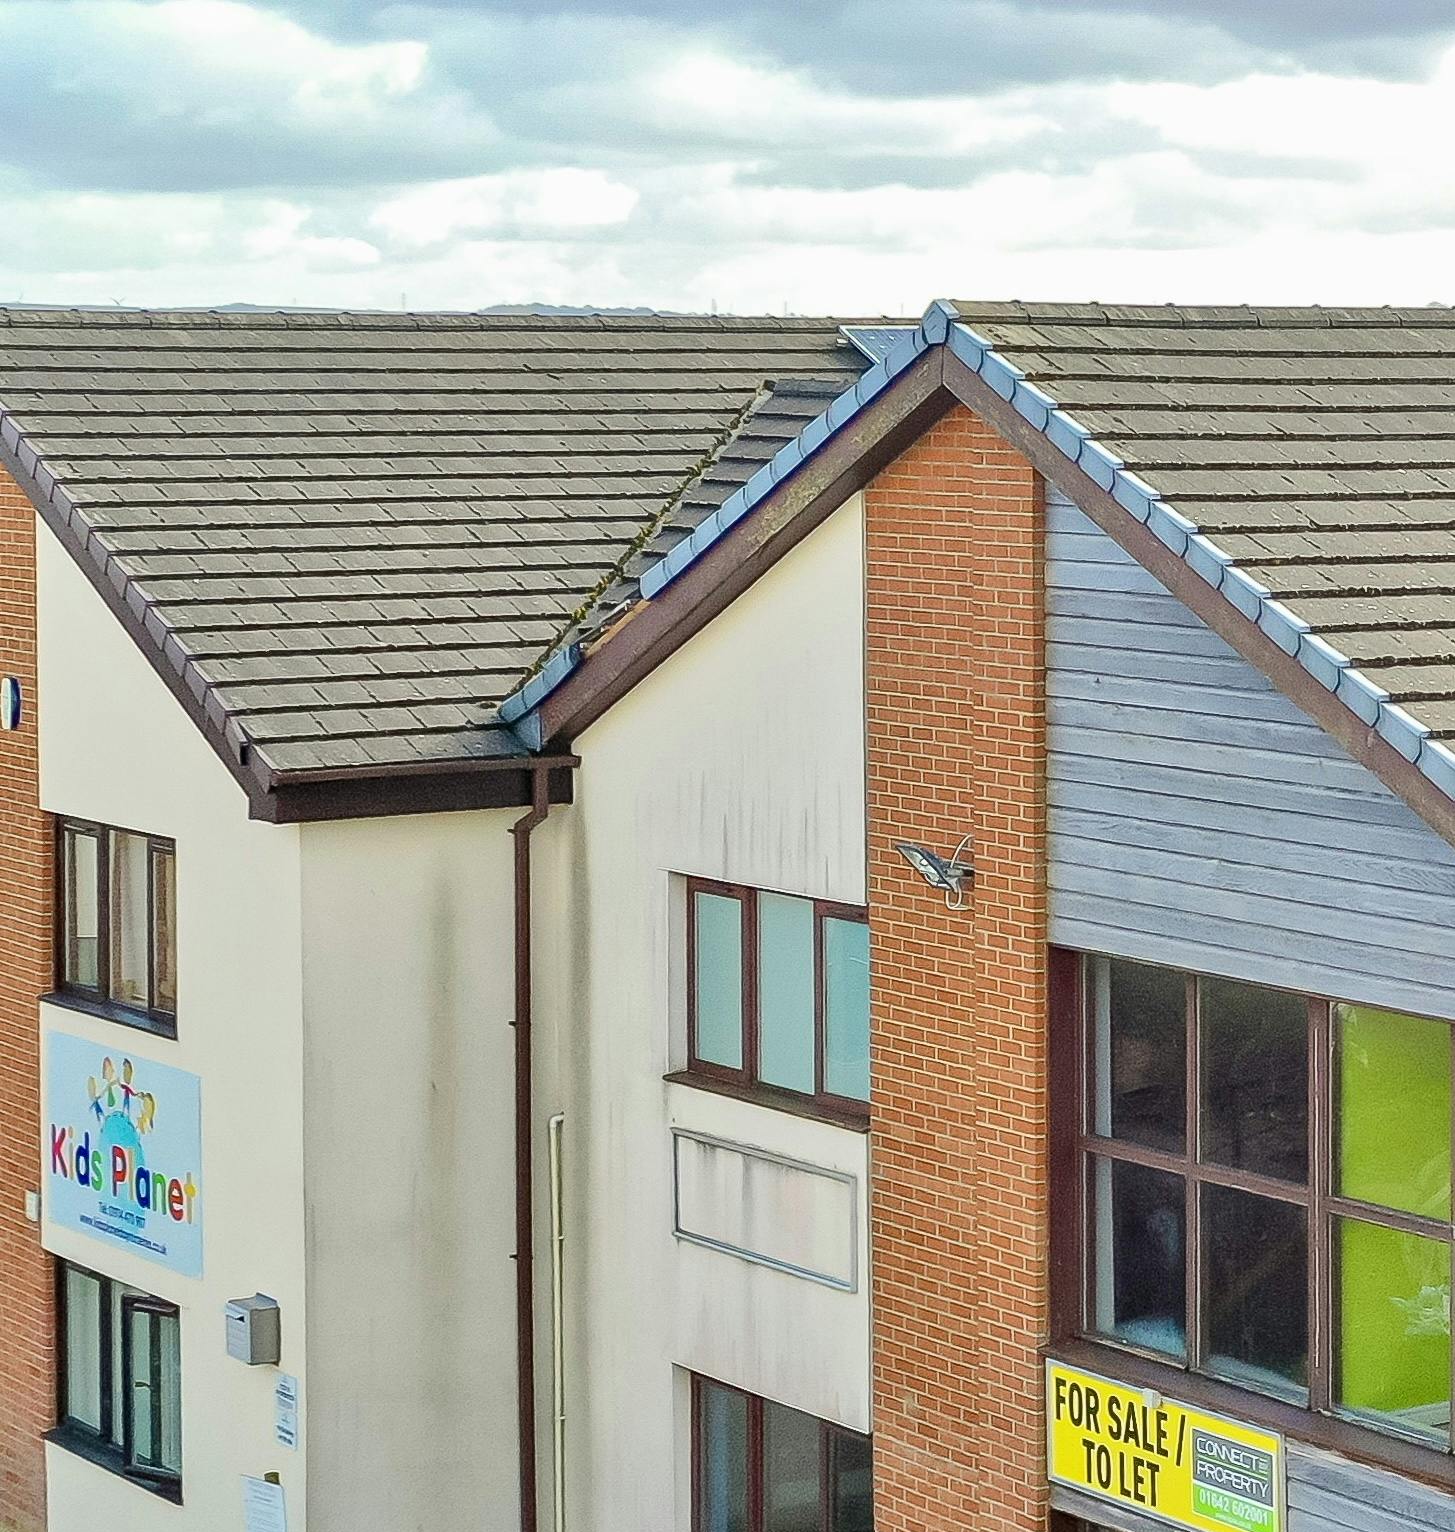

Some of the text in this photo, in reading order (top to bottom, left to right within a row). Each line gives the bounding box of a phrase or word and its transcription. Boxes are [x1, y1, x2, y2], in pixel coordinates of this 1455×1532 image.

[50, 1123, 197, 1224] Kids Planet
[1055, 1377, 1186, 1467] FOR SALE /
[1082, 1438, 1160, 1507] TO LET
[1196, 1460, 1269, 1498] PROPERTY
